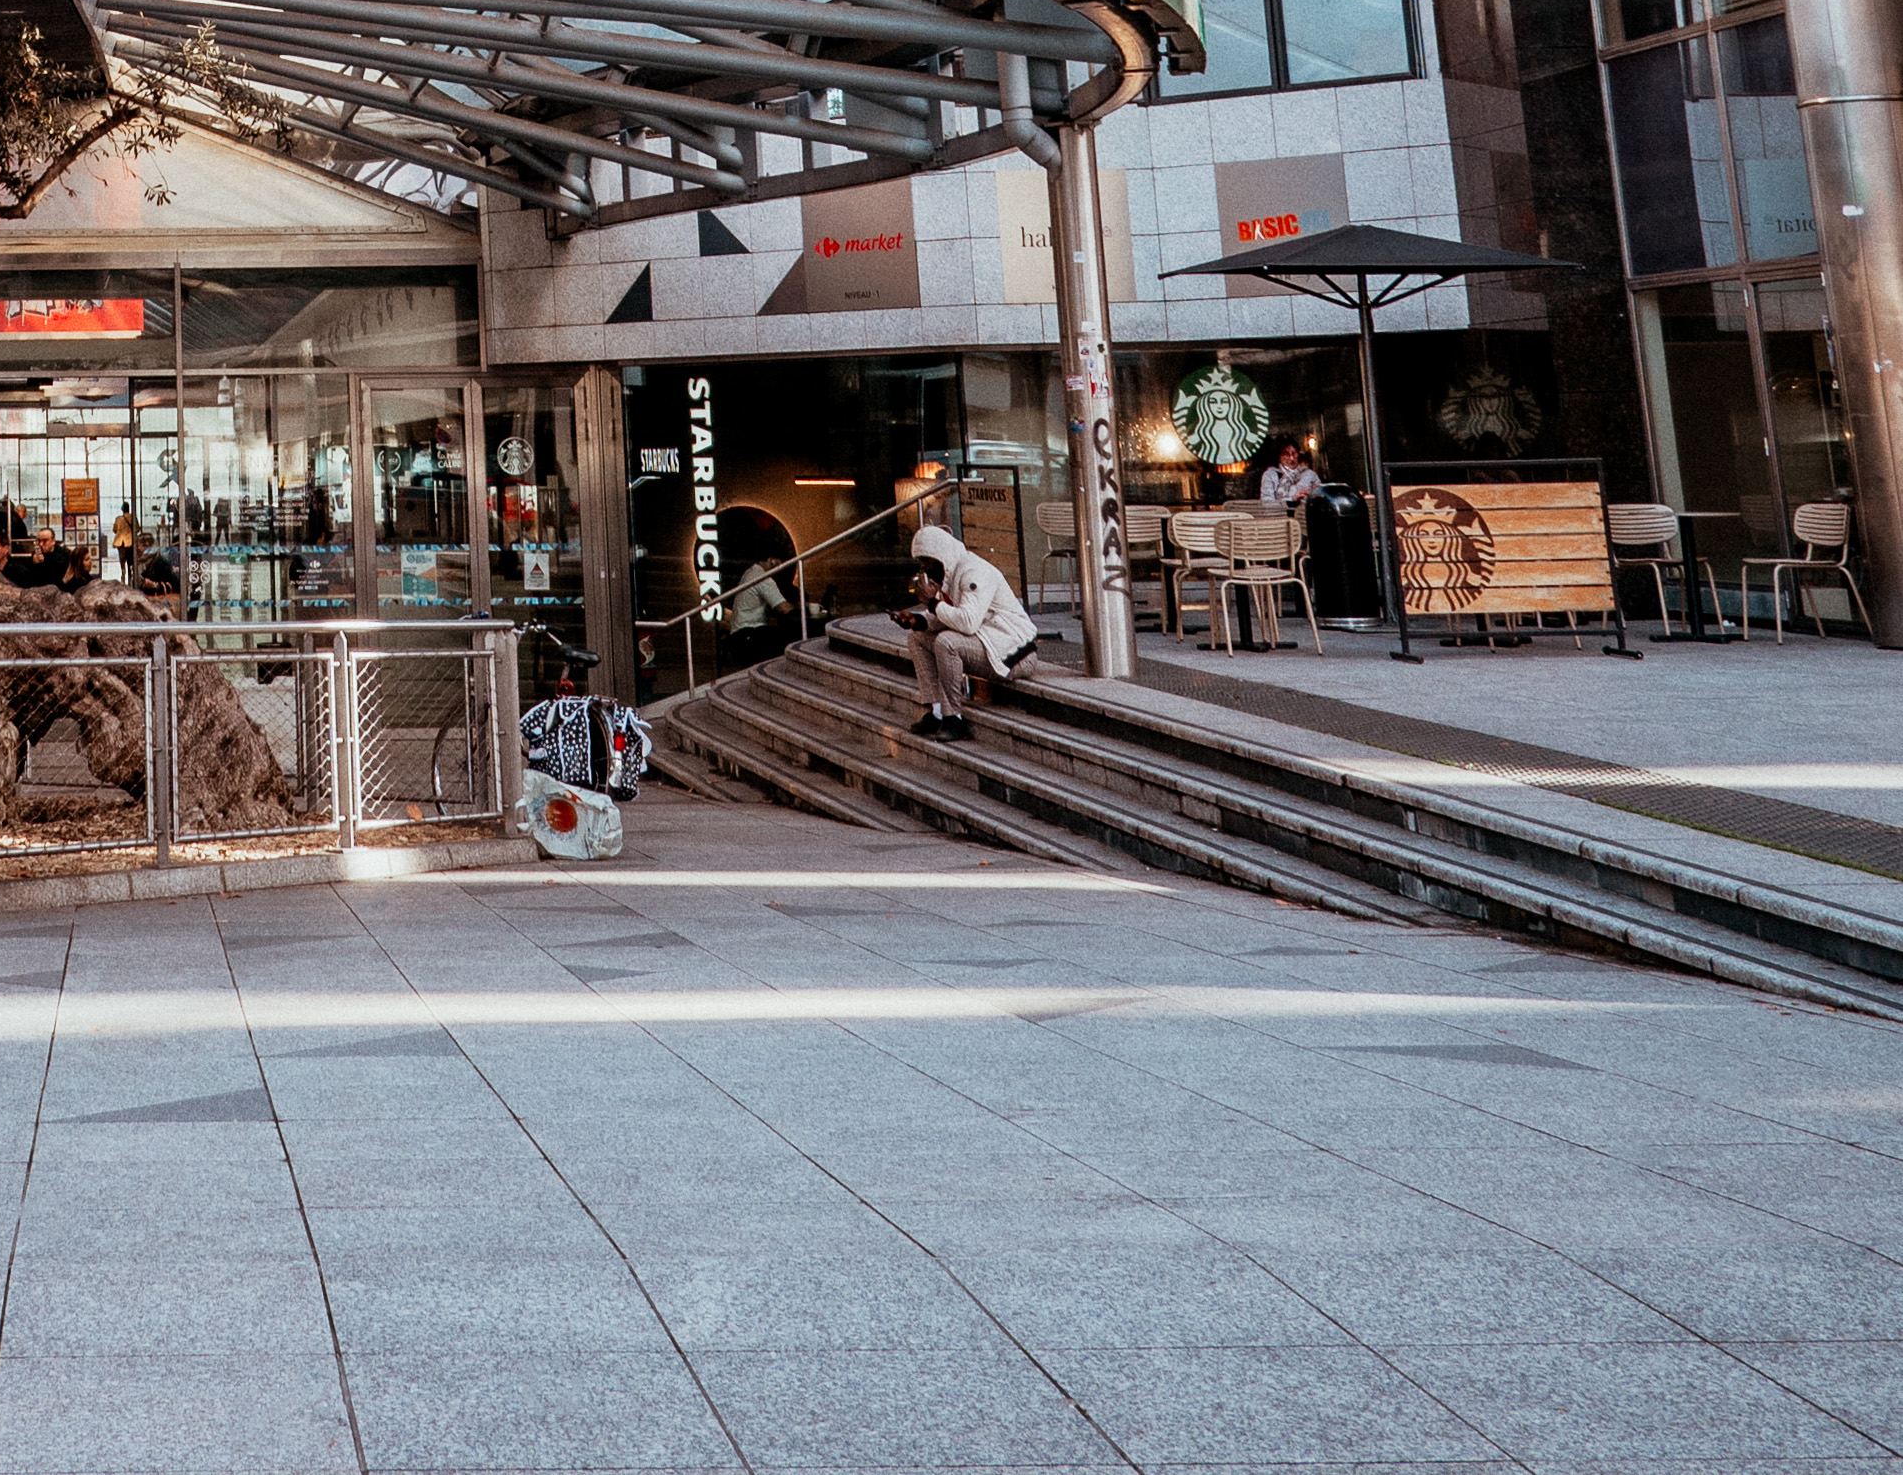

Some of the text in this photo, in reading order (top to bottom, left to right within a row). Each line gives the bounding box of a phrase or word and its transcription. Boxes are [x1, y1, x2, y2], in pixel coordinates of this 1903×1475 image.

[1238, 214, 1299, 241] BASIC
[844, 233, 903, 252] market
[845, 291, 871, 299] NIVEAU
[641, 447, 680, 473] STARBUCKS
[688, 377, 723, 622] STARBUCKS
[968, 487, 1007, 502] STARBUCKS
